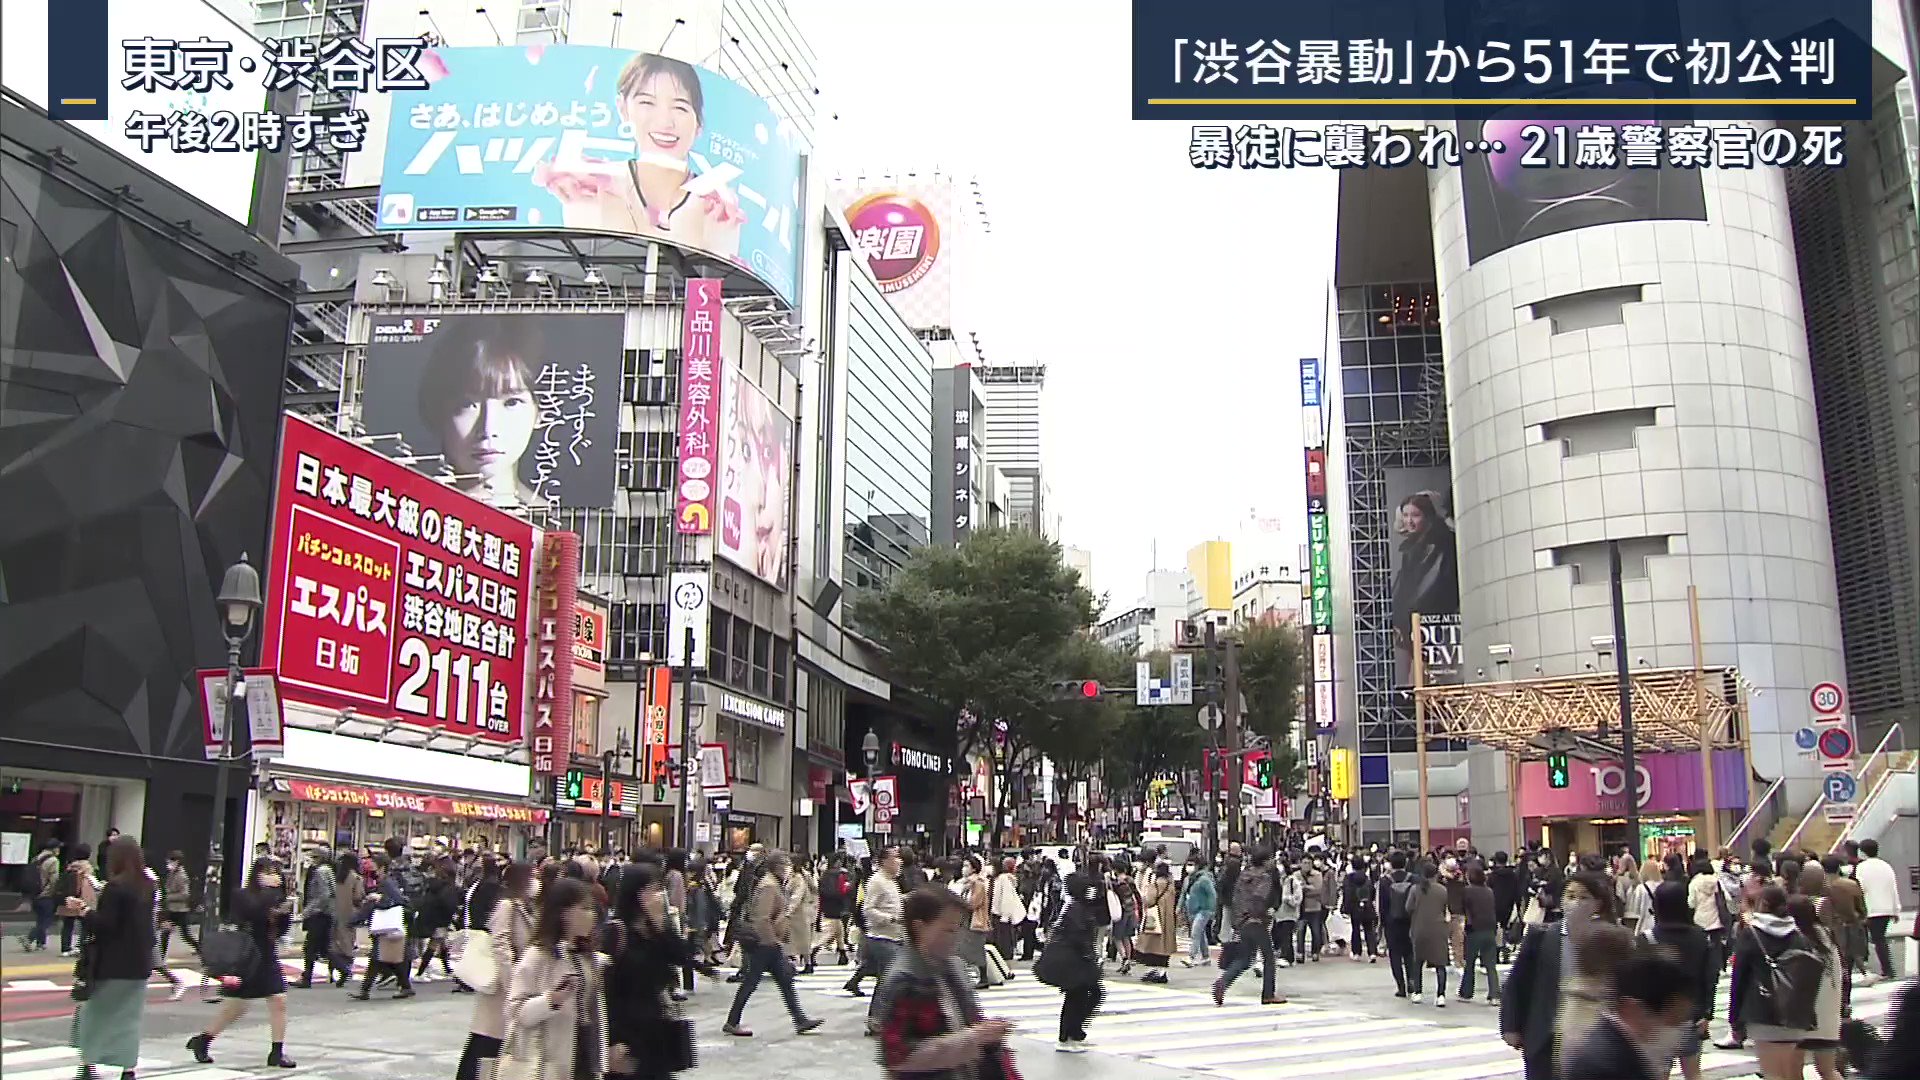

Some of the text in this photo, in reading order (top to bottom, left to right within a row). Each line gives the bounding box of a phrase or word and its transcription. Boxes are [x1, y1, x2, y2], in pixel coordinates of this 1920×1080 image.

[409, 102, 612, 130] さあ、はじめよう
[685, 310, 714, 456] 品川美容外科
[530, 362, 570, 501] 生きてきた
[562, 363, 596, 466] まっすぐ
[295, 452, 520, 578] 日本最大級の超大型店
[296, 531, 391, 582] パチンコ&スロット
[291, 575, 388, 637] エスパス
[404, 550, 517, 620] エスパス日拓
[403, 594, 516, 660] 渋谷地区合計
[315, 637, 360, 676] 日拓
[488, 716, 509, 734] OVER
[1818, 691, 1836, 706] 30
[901, 746, 952, 775] TOHO CINES
[1590, 766, 1652, 808] 109
